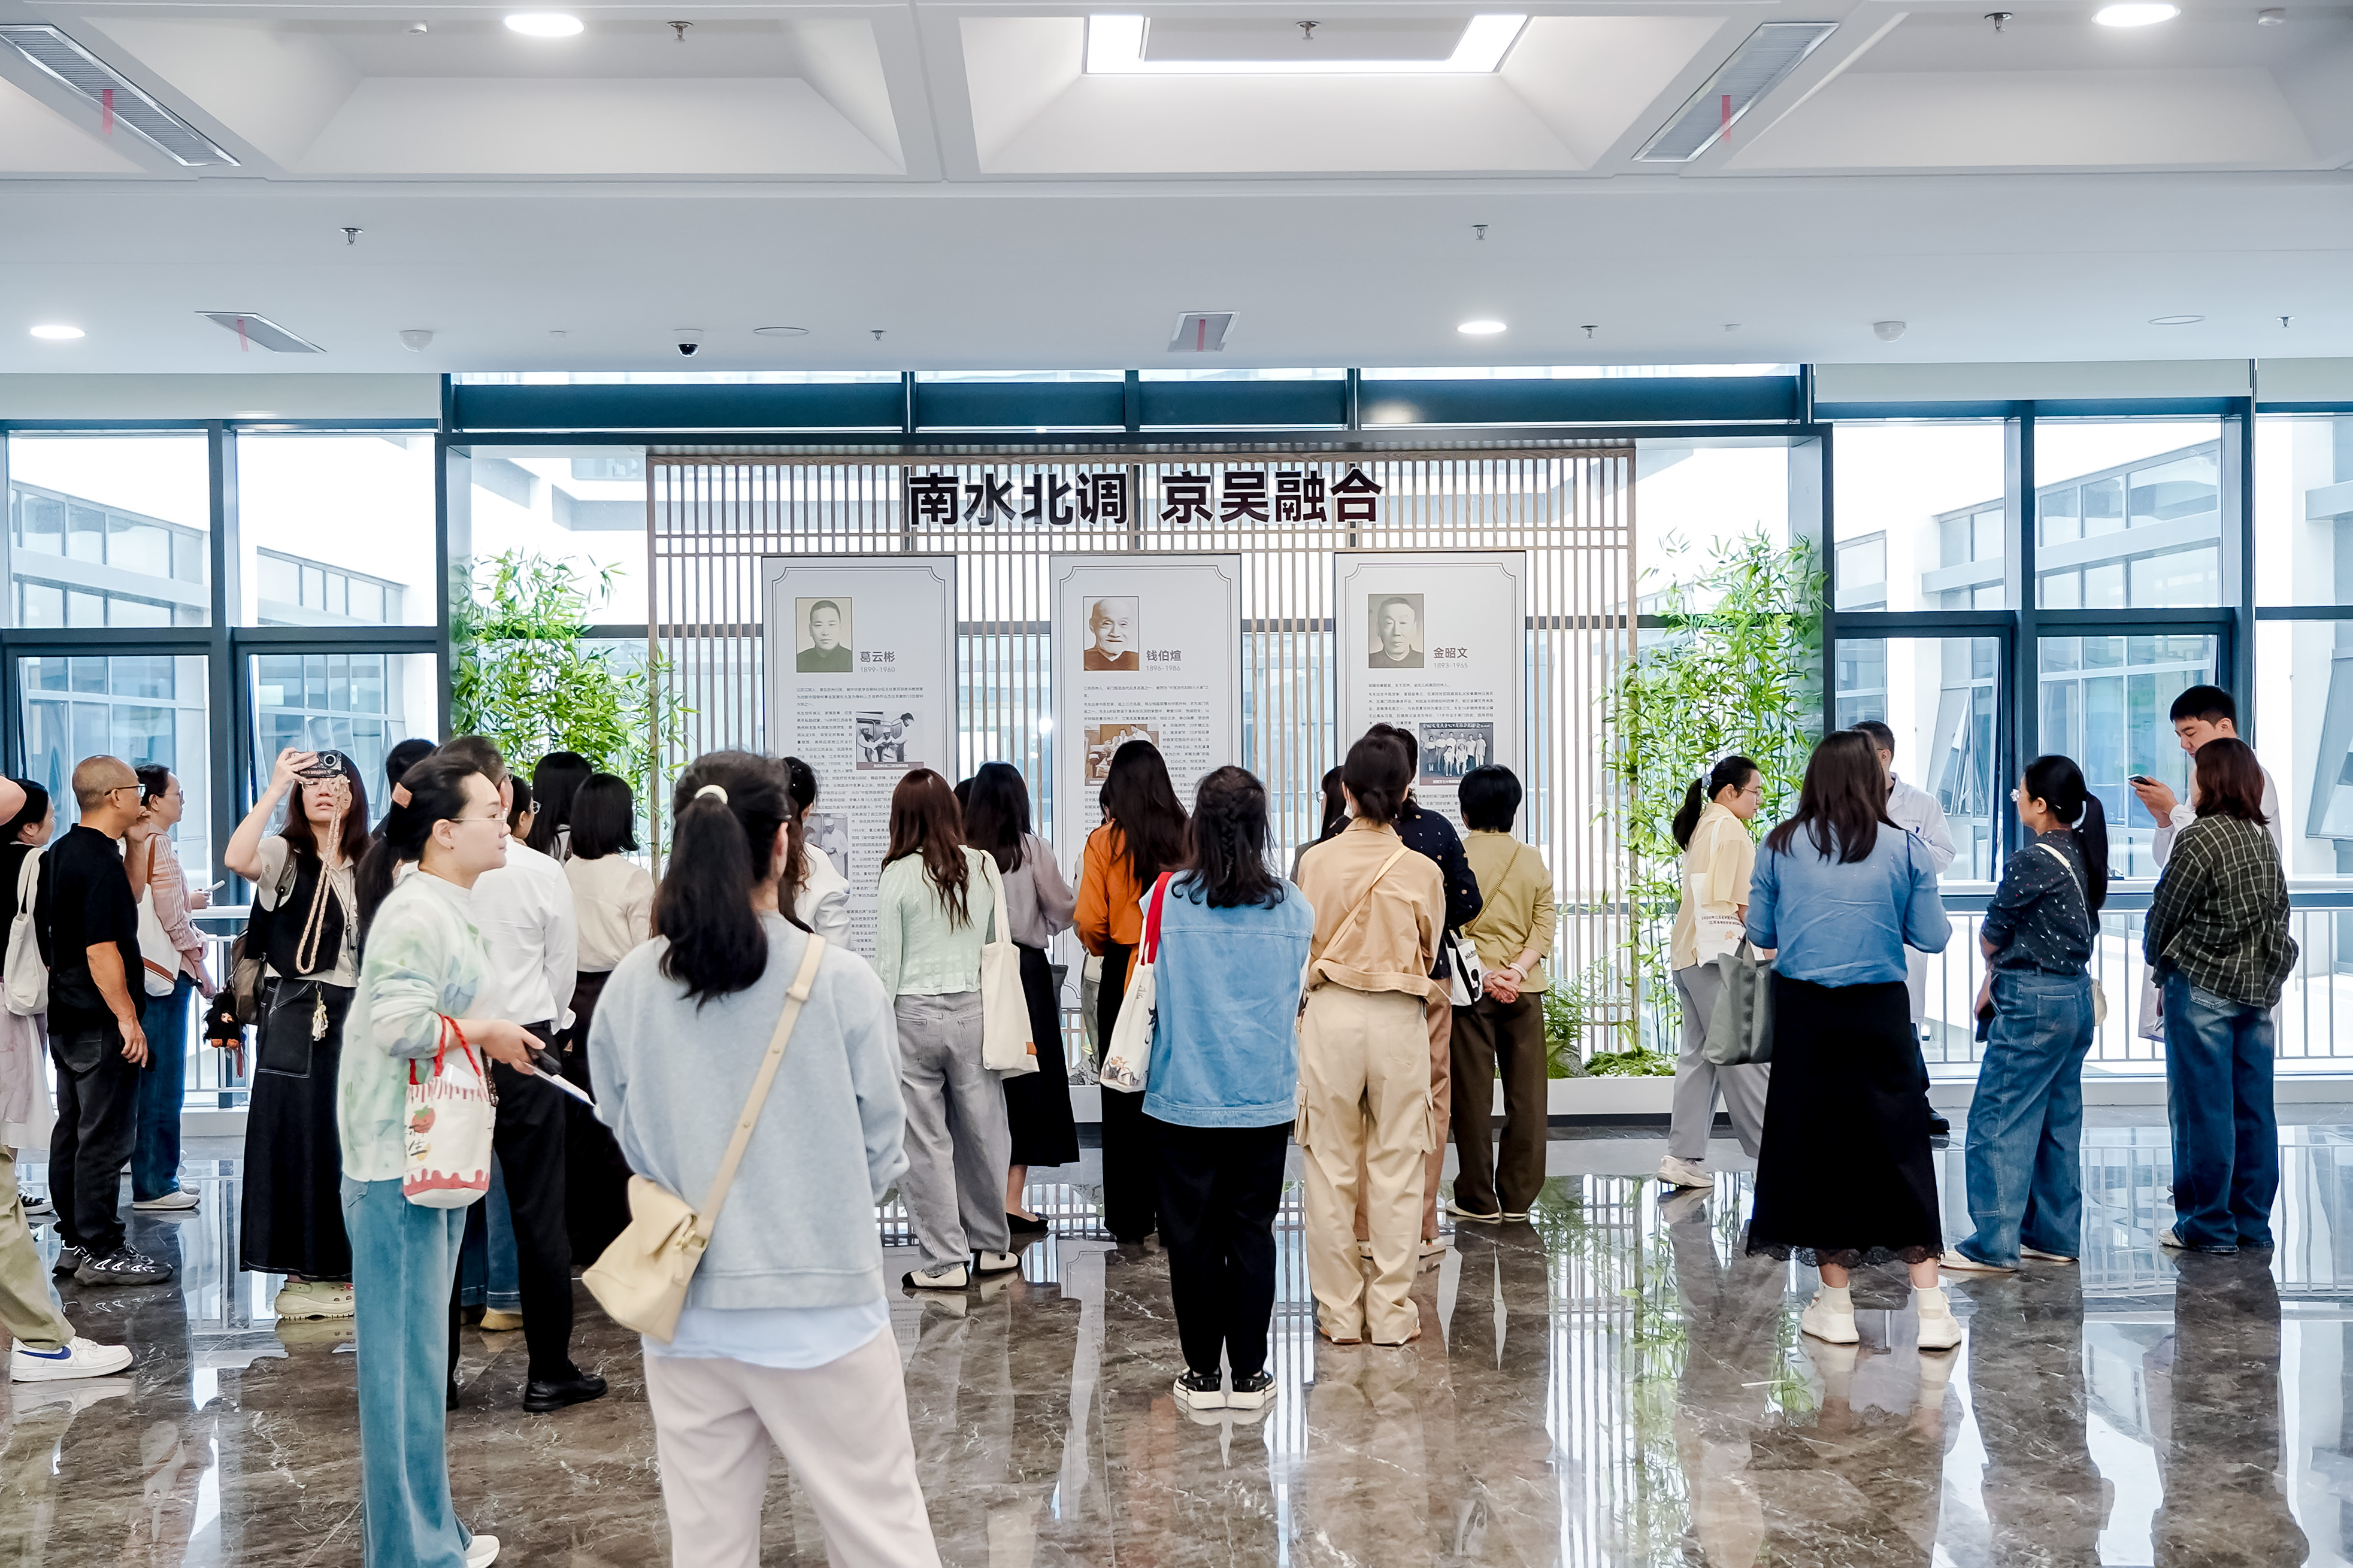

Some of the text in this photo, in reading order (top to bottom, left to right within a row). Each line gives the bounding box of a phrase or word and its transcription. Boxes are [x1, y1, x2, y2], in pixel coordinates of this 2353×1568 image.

[908, 467, 1383, 526] 南水北调 京吴融合
[859, 651, 895, 663] 葛云彬
[1146, 649, 1182, 662] 钱伯煊
[1433, 647, 1468, 659] 金昭文
